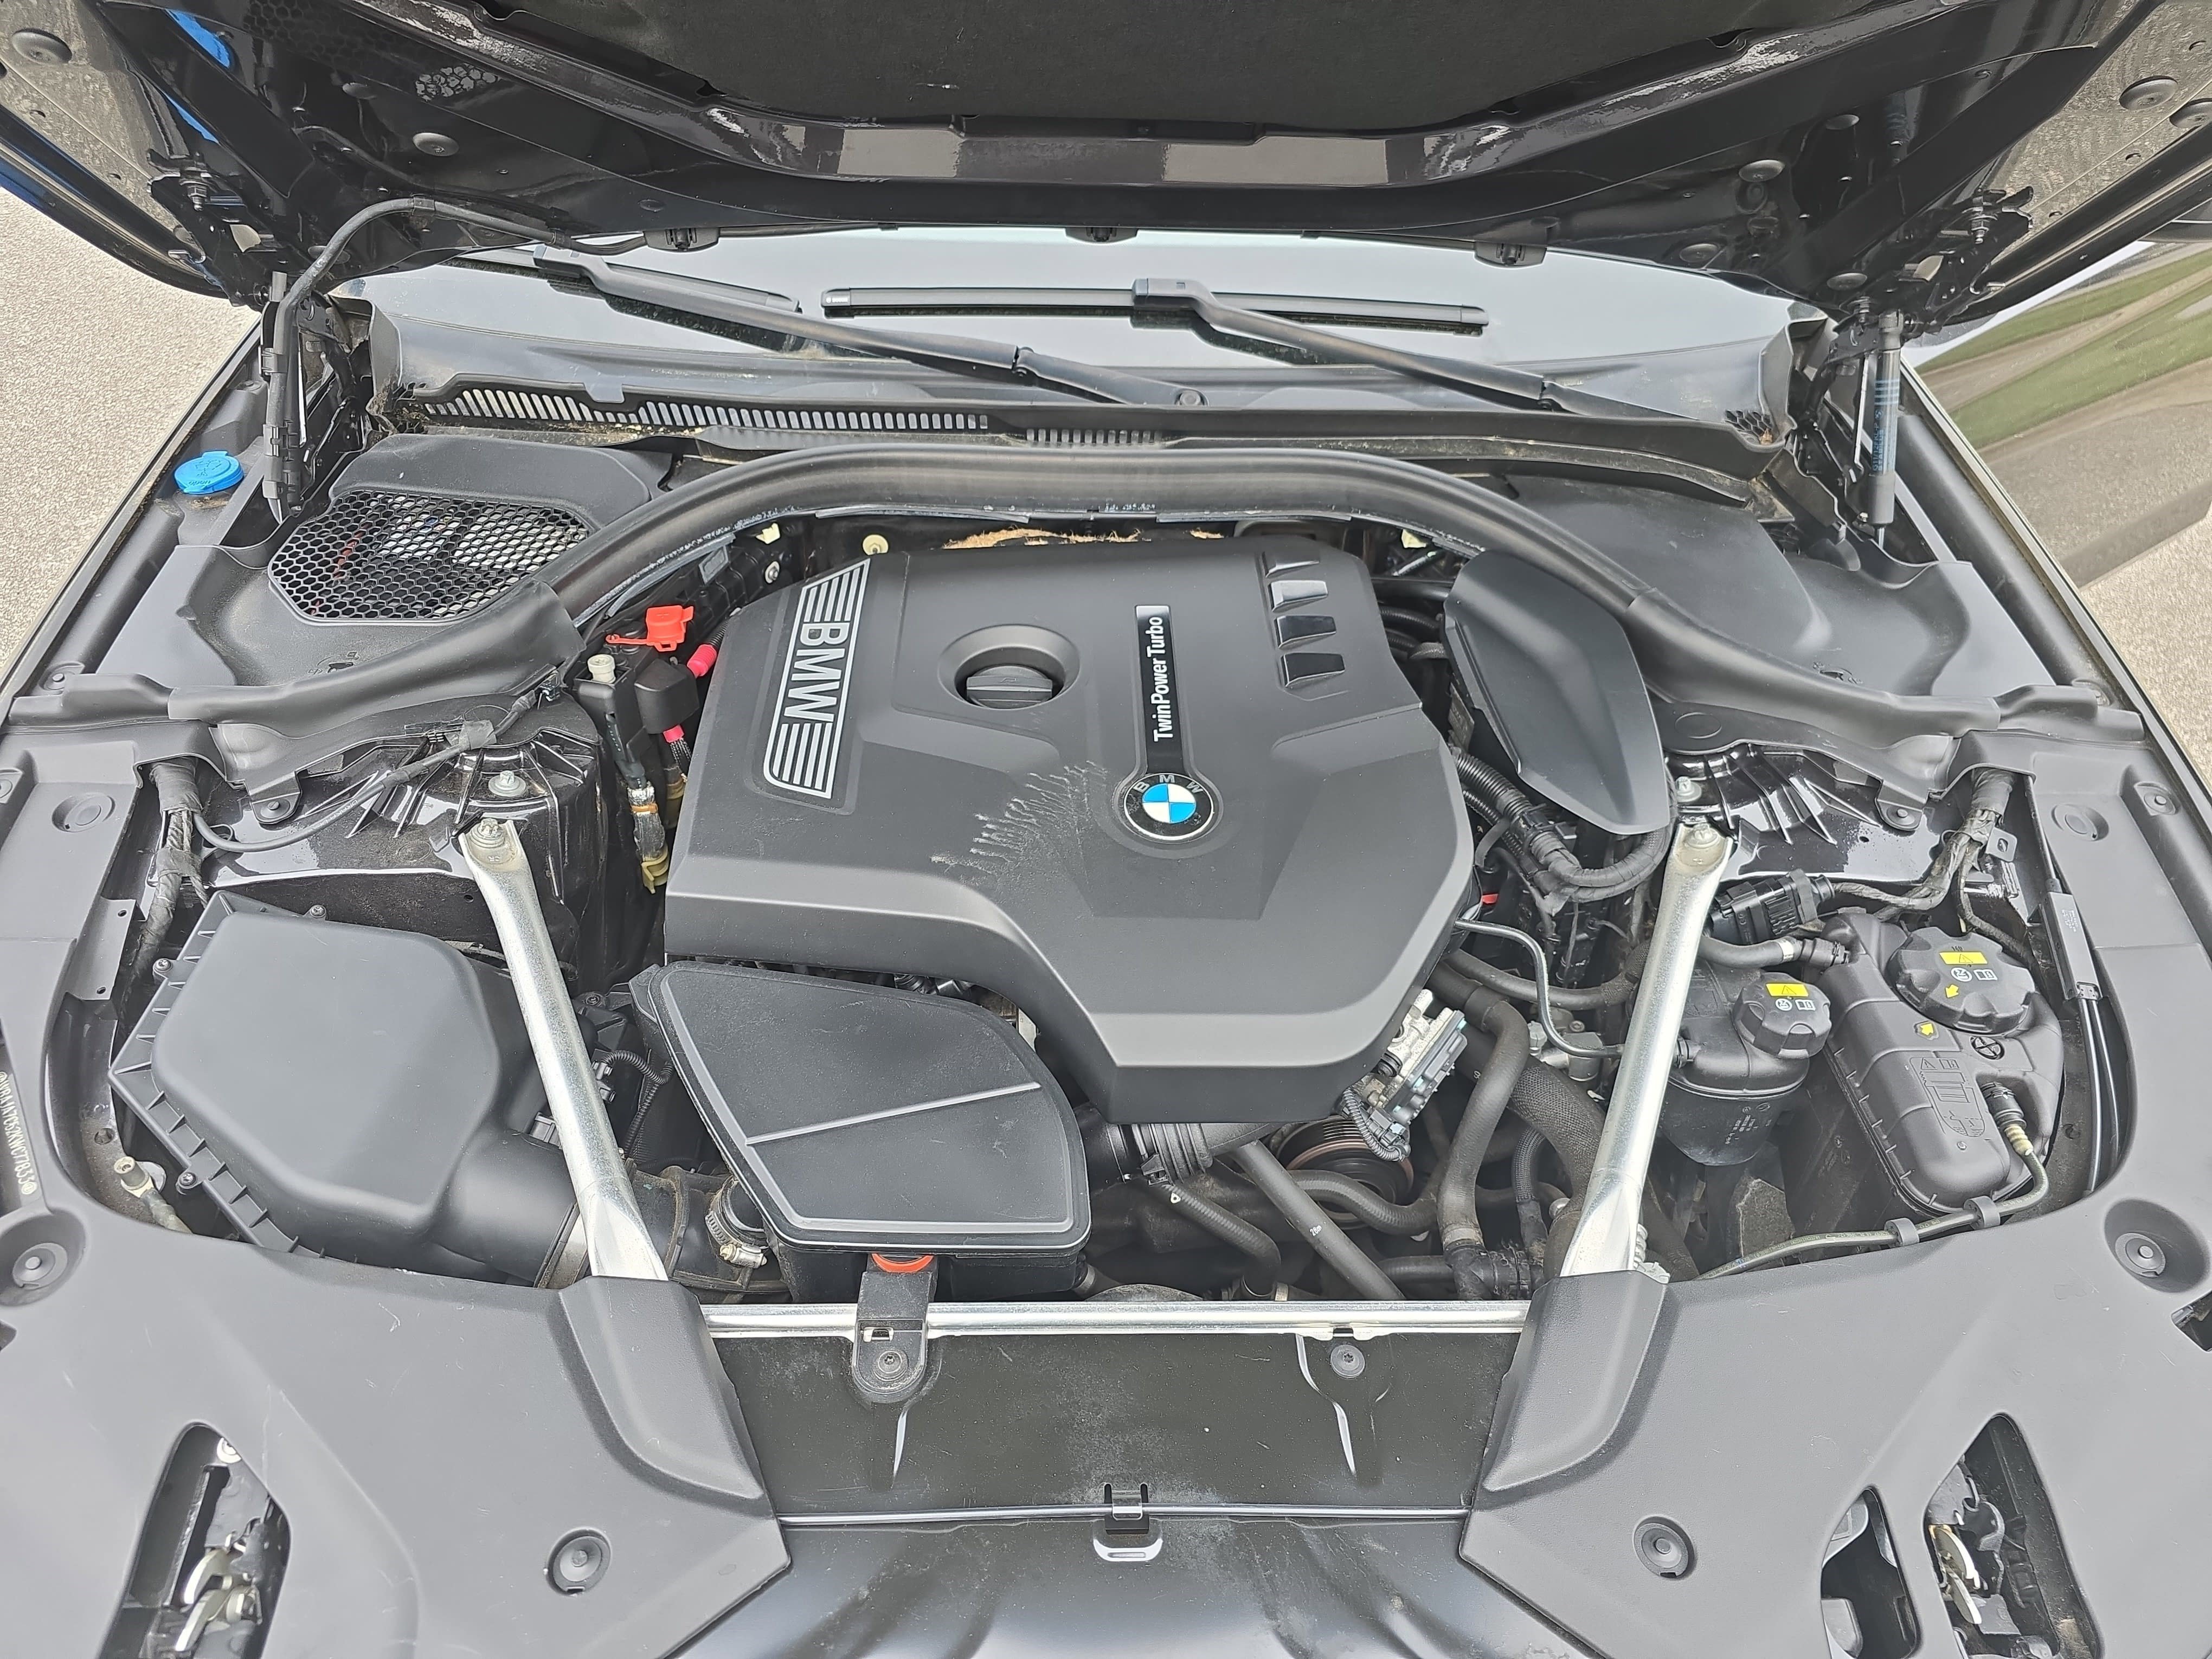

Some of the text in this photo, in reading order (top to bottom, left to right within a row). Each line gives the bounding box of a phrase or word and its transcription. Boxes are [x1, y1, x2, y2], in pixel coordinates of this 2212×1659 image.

[783, 622, 850, 722] BMW
[1145, 616, 1173, 742] TwinPower Turbo
[1135, 774, 1204, 794] BMW
